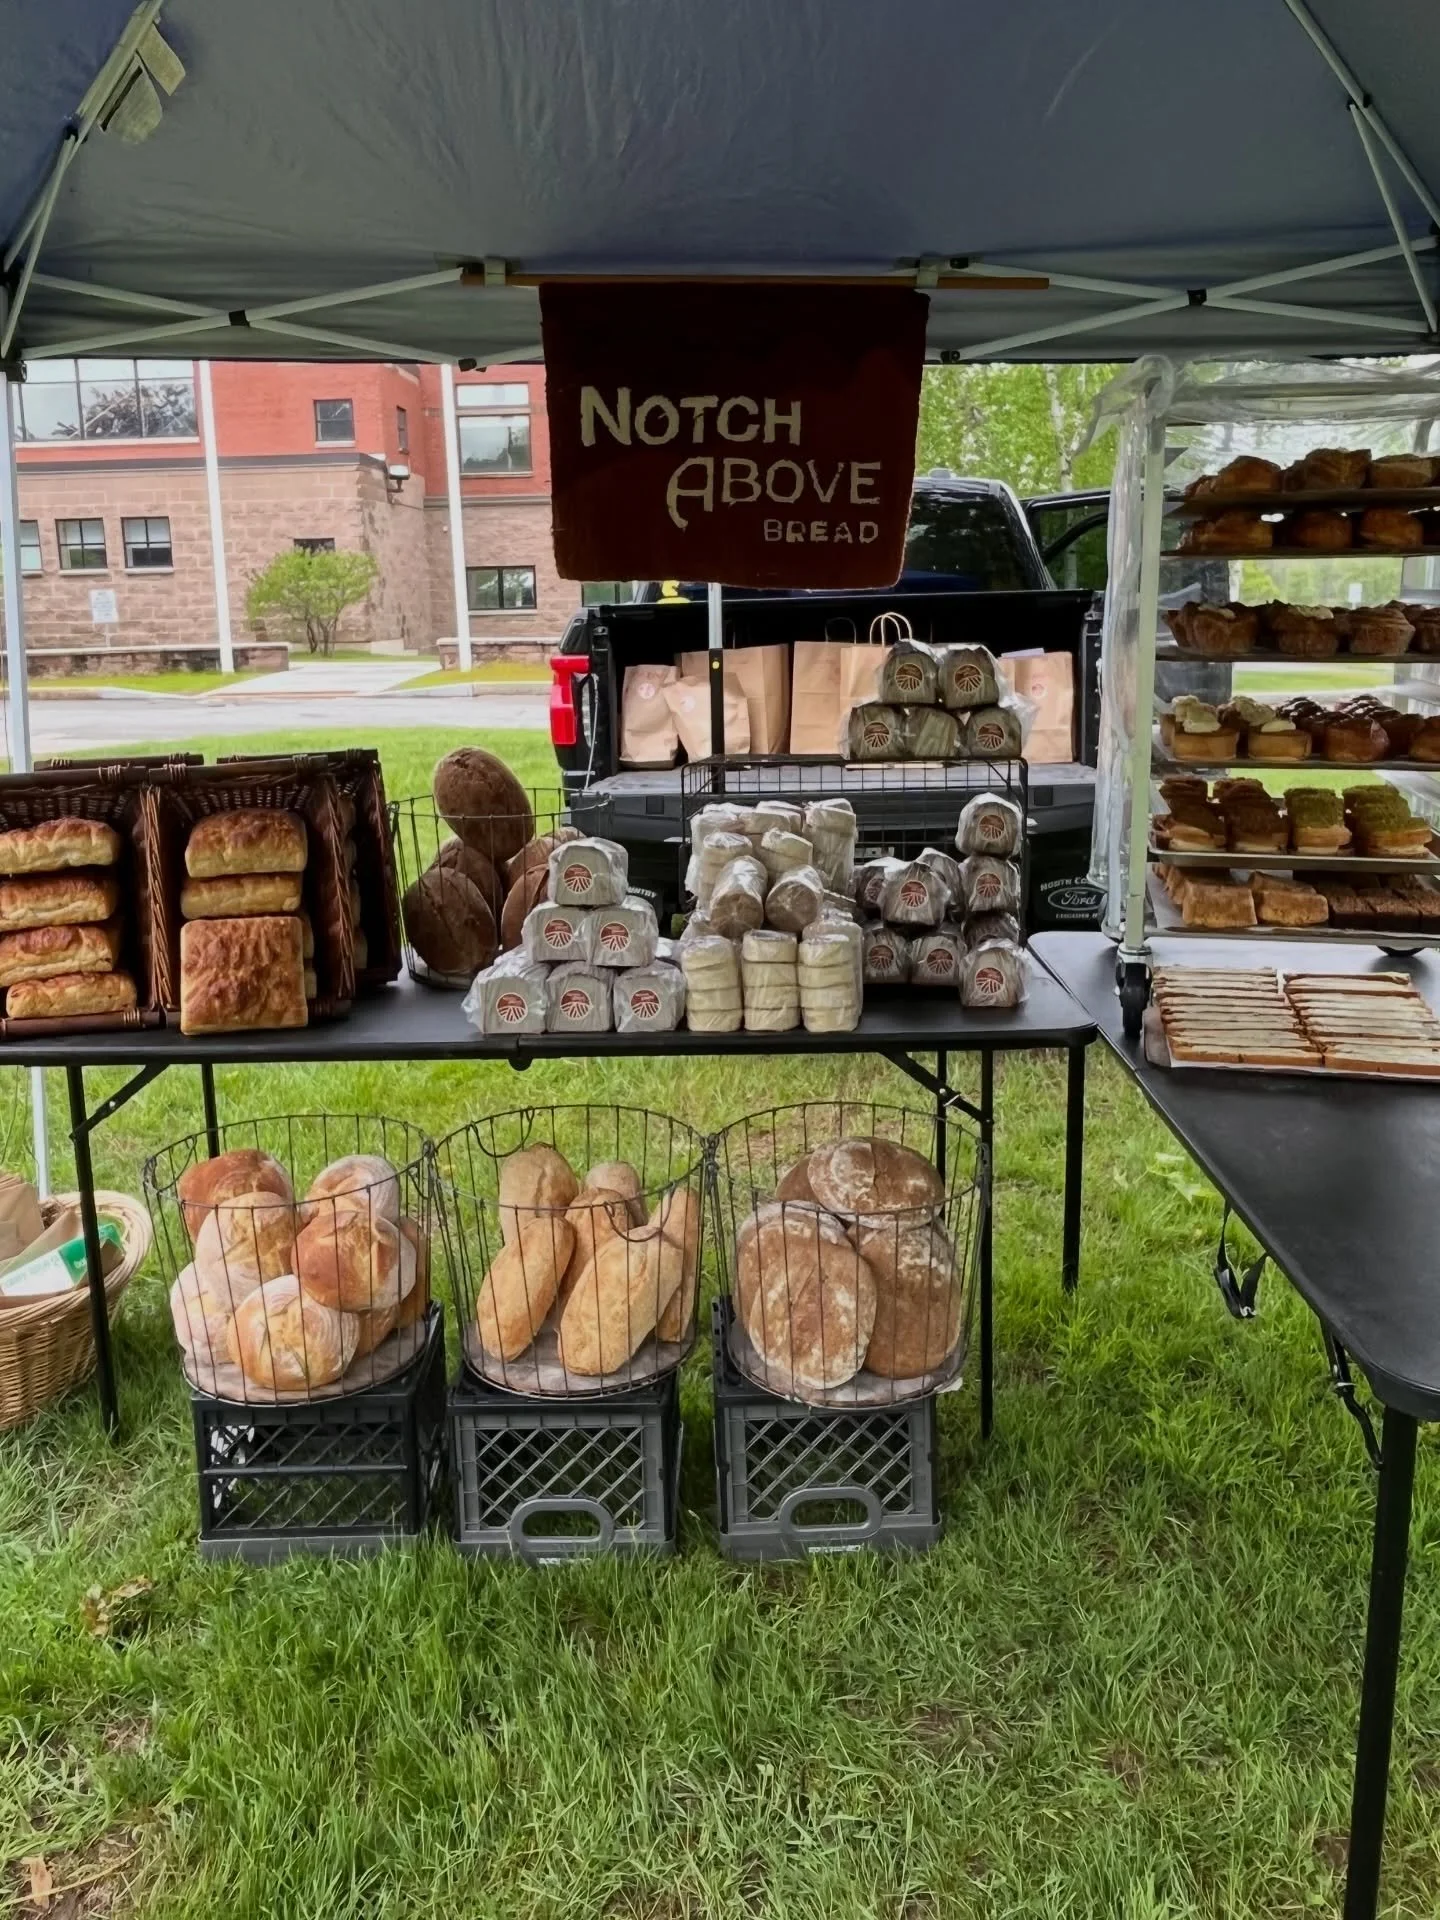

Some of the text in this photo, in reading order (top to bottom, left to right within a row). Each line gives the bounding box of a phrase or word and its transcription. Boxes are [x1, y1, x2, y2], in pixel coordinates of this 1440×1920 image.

[580, 386, 801, 446] NOTCH
[666, 456, 880, 530] ABOVE
[763, 519, 879, 543] BREAD
[1061, 891, 1096, 905] Ford
